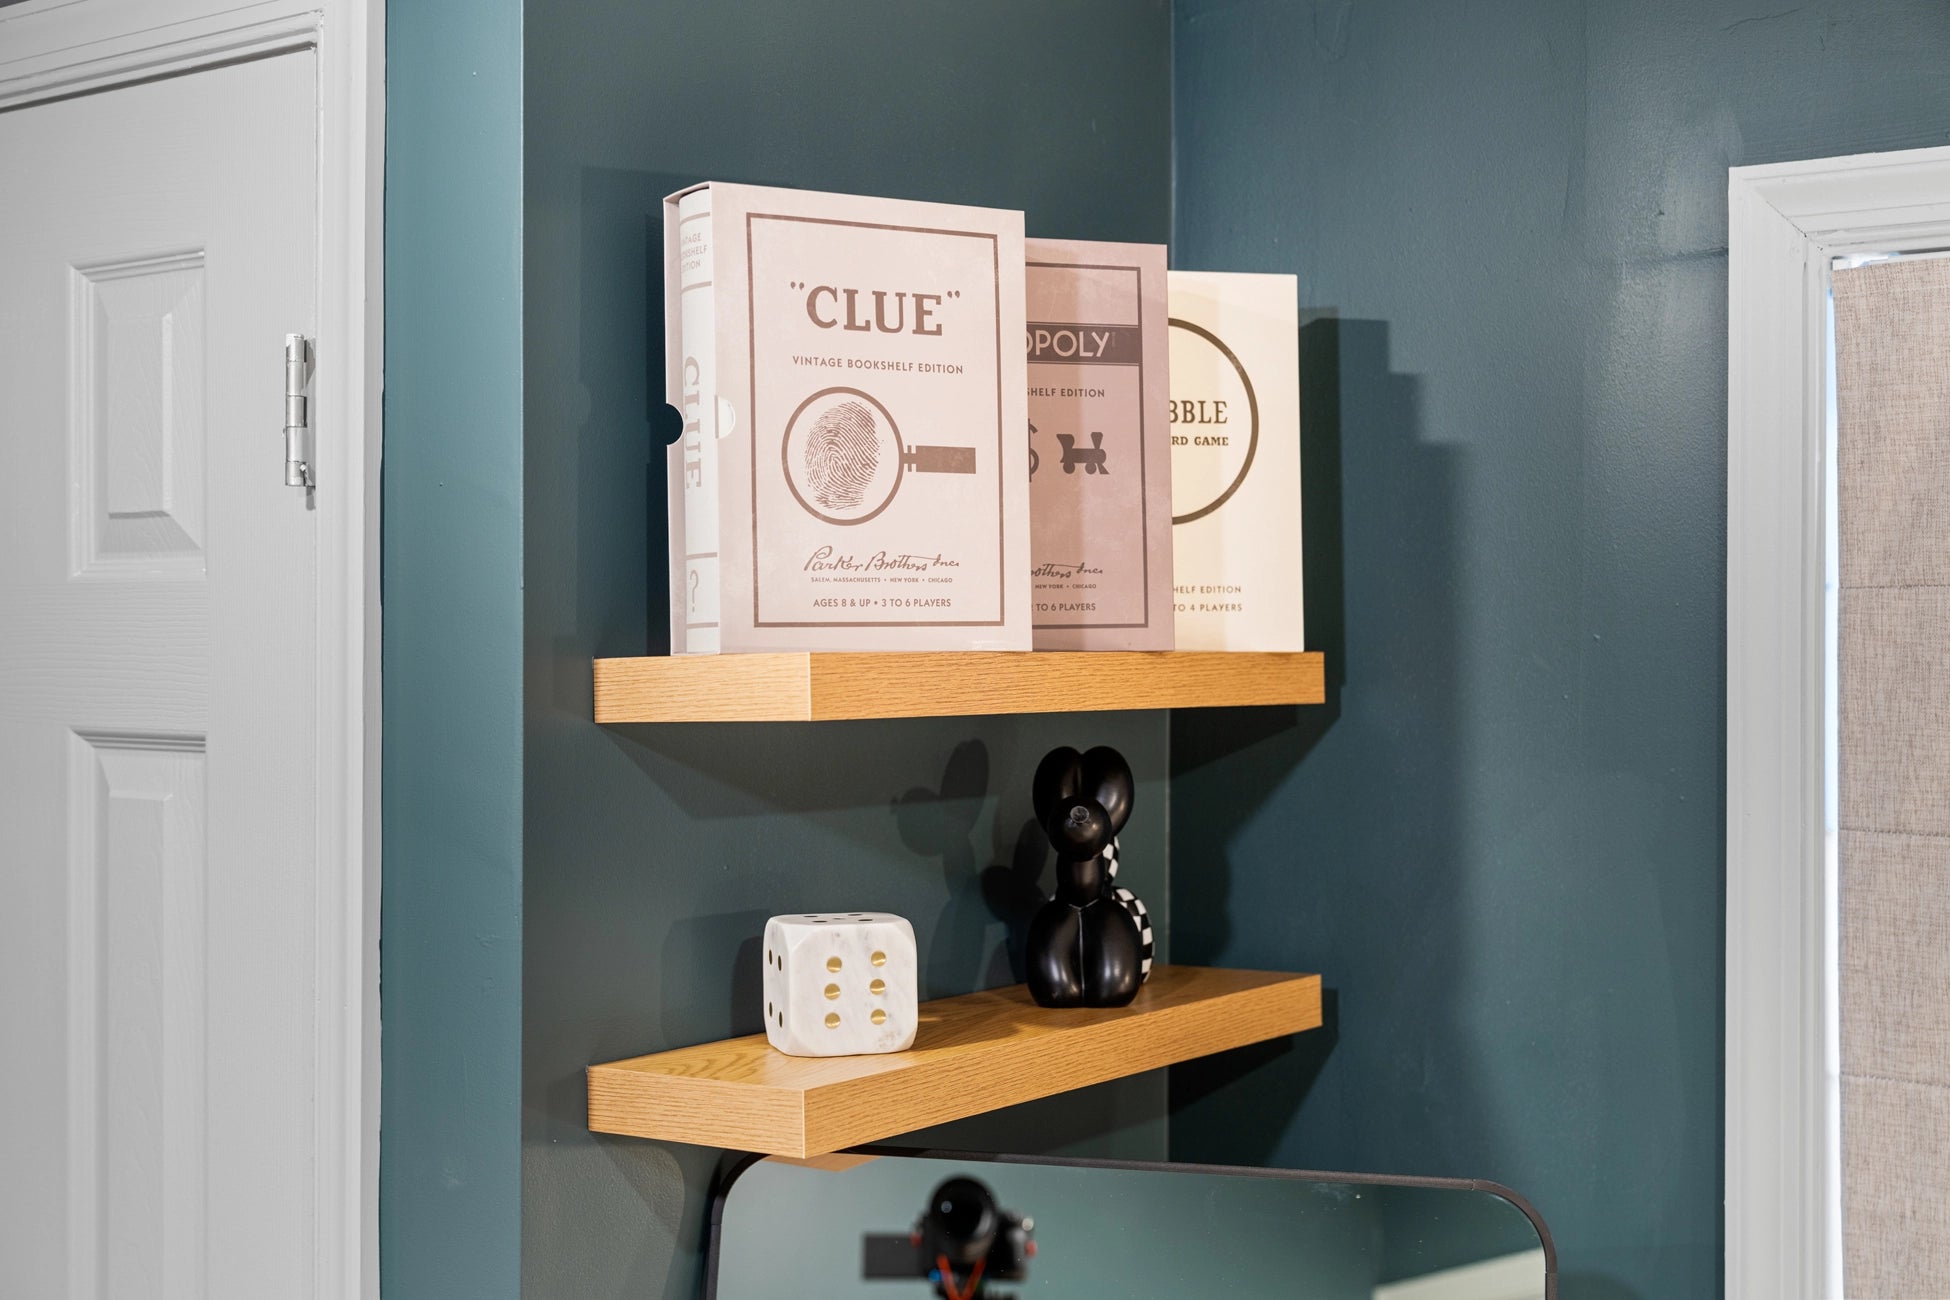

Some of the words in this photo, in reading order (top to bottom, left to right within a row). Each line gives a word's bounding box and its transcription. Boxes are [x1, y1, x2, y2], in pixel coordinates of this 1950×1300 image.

[790, 281, 961, 336] "CLUE"
[792, 356, 843, 368] VINTAGE
[847, 359, 914, 372] BOOKSHELF
[918, 362, 964, 375] EDITION
[1060, 388, 1105, 398] EDITION
[684, 356, 702, 490] CLUE
[1194, 436, 1229, 446] GAME
[803, 545, 864, 571] Parker
[864, 551, 928, 572] Brothers
[1200, 585, 1242, 594] EDITION
[813, 599, 839, 608] AGES
[841, 599, 847, 608] 8
[849, 599, 857, 608] &
[859, 599, 871, 608] UP
[881, 599, 887, 608] 3
[891, 599, 903, 608] TO
[905, 599, 911, 608] 6
[913, 599, 952, 608] PLAYERS
[1036, 603, 1049, 612] TO
[1050, 603, 1057, 612] 6
[1059, 603, 1096, 611] PLAYERS
[1190, 603, 1195, 612] 4
[1199, 603, 1243, 612] PLAYERS
